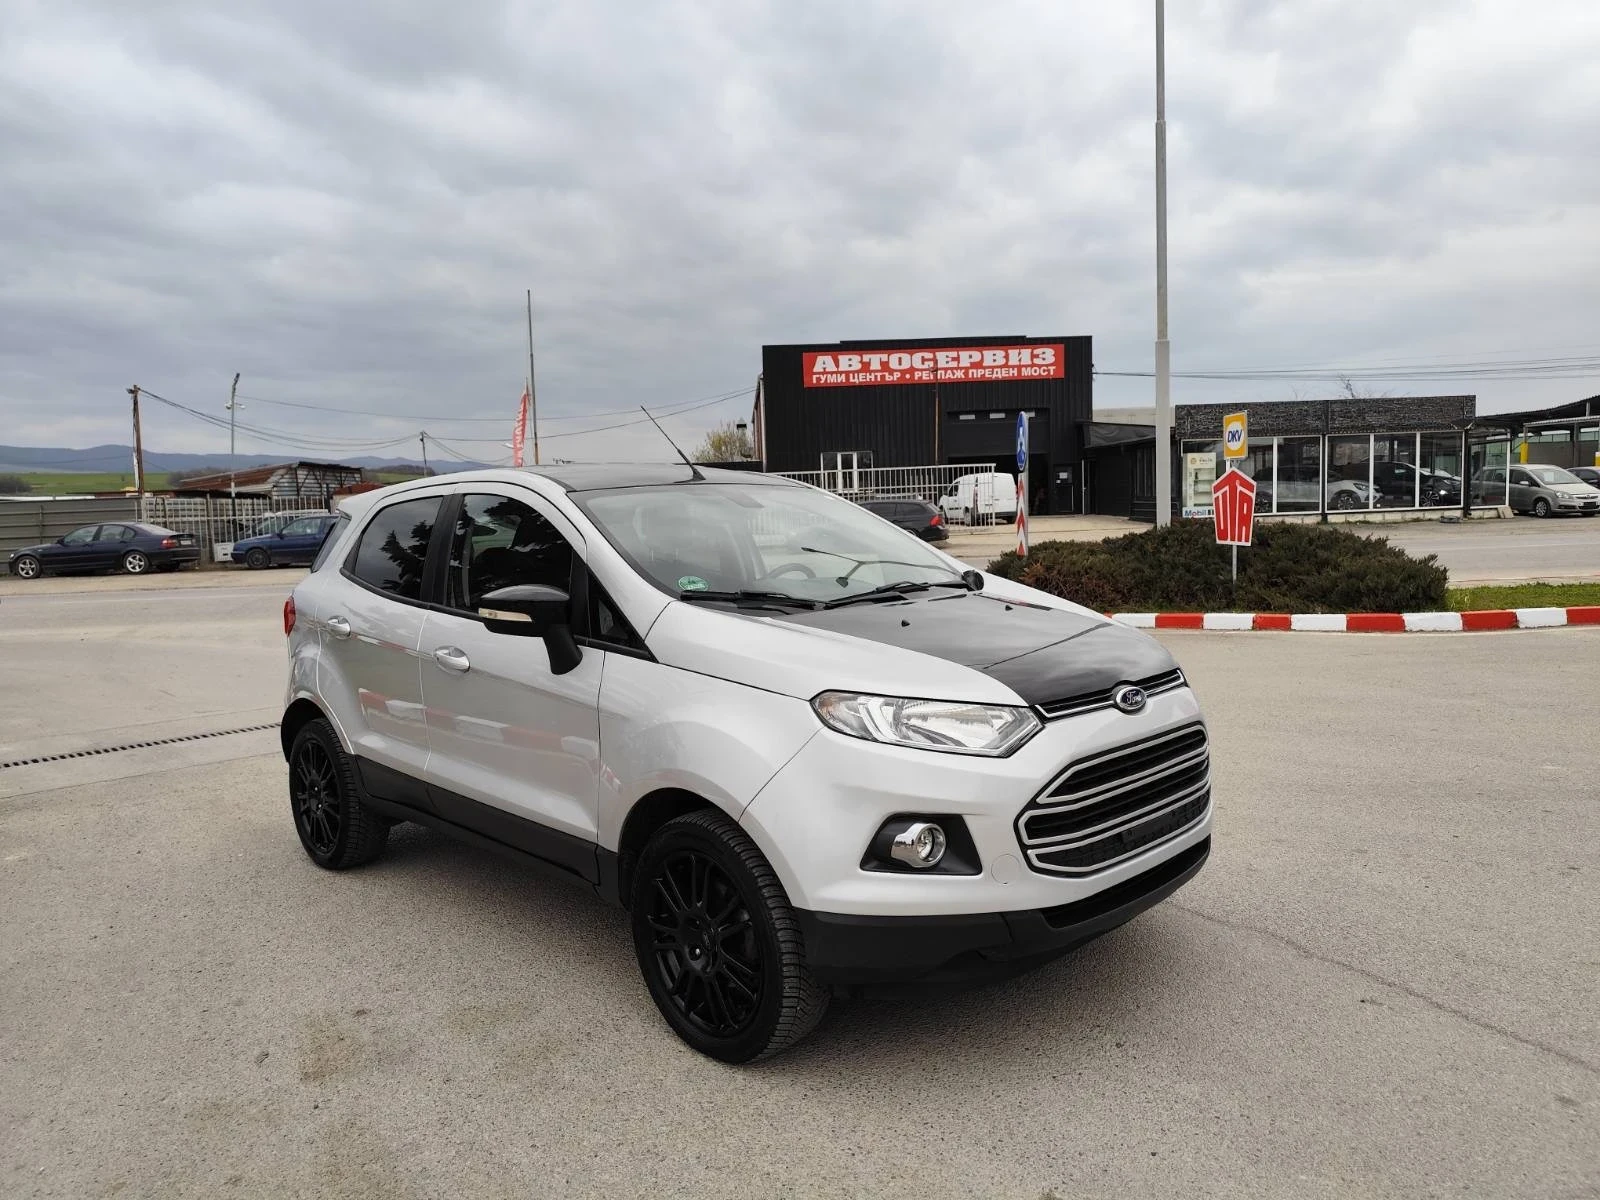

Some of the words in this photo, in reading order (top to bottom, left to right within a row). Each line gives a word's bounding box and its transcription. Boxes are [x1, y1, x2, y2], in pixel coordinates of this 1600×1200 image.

[812, 347, 1056, 373] АВТОСЕРВИЗ
[812, 373, 845, 384] ГУМИ
[849, 372, 901, 384] ЦЕНТЪР
[968, 367, 1018, 379] ПРЕДЕН
[1021, 366, 1056, 377] МОСТ
[1227, 429, 1243, 443] DKV
[1184, 509, 1207, 517] Mobil
[1126, 690, 1142, 704] Ford
